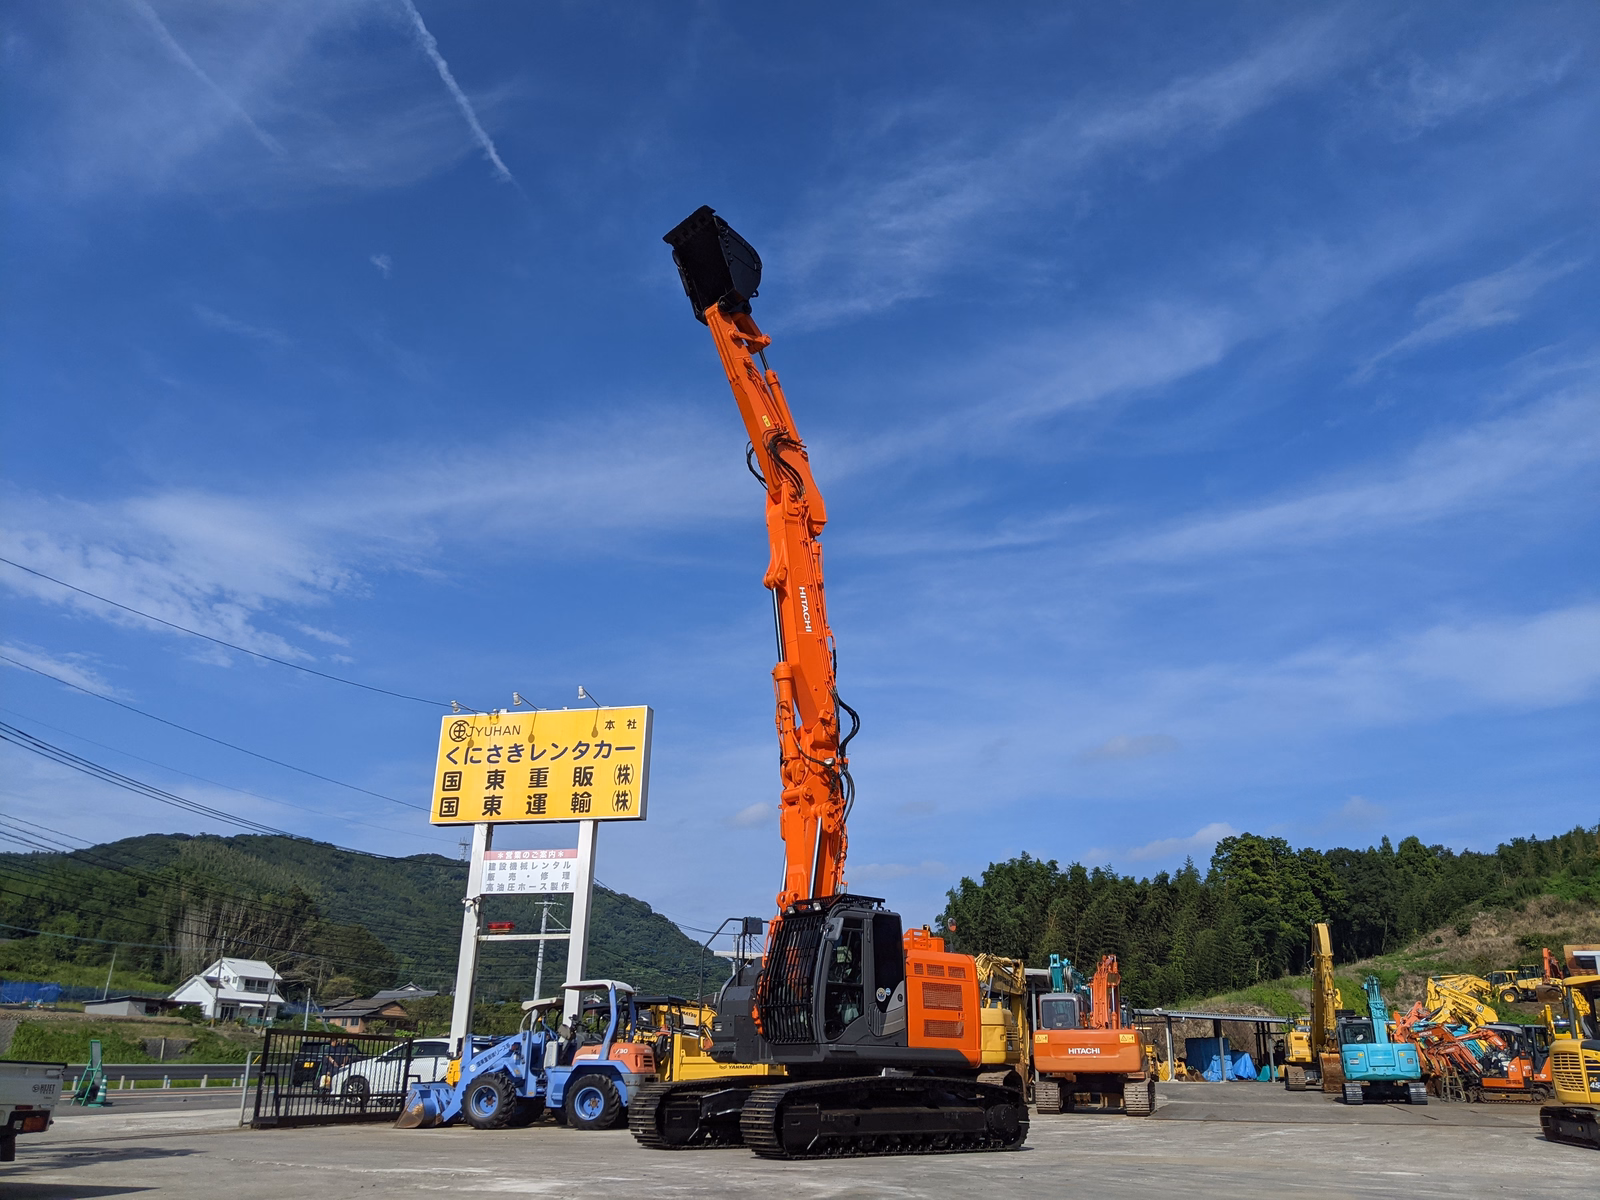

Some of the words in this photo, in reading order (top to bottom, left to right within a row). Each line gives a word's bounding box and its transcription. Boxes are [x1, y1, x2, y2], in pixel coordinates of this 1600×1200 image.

[798, 586, 812, 632] HITACHI
[604, 719, 637, 731] 本社
[466, 725, 521, 738] JYUHAN
[446, 740, 636, 765] くにさきレンタカー
[675, 1009, 698, 1019] KMATSU
[1068, 1047, 1101, 1055] HITACHI
